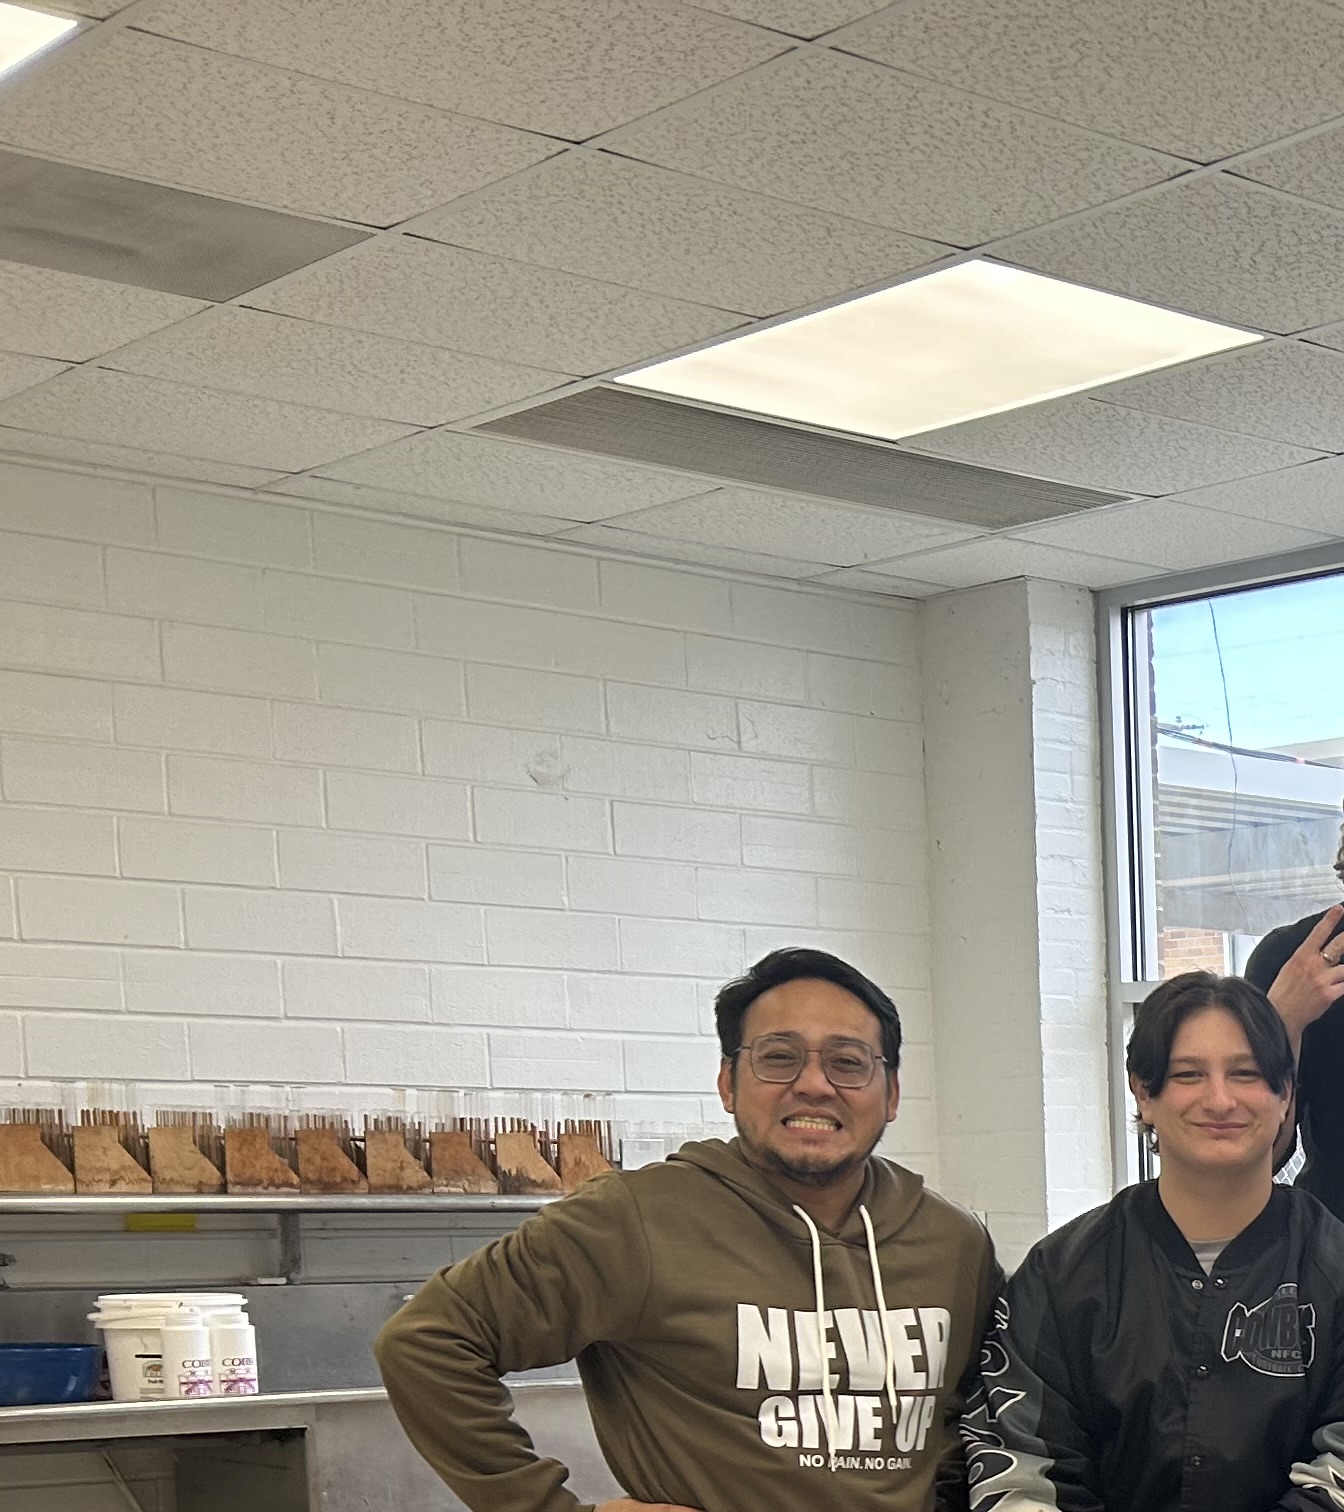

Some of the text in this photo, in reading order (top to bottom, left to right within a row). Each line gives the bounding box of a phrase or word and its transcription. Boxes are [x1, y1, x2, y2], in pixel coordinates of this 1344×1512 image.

[736, 1303, 951, 1391] NEVER
[1271, 1349, 1302, 1360] NFC
[758, 1395, 936, 1452] GIVE UP
[799, 1454, 825, 1467] NO
[864, 1457, 885, 1470] NO
